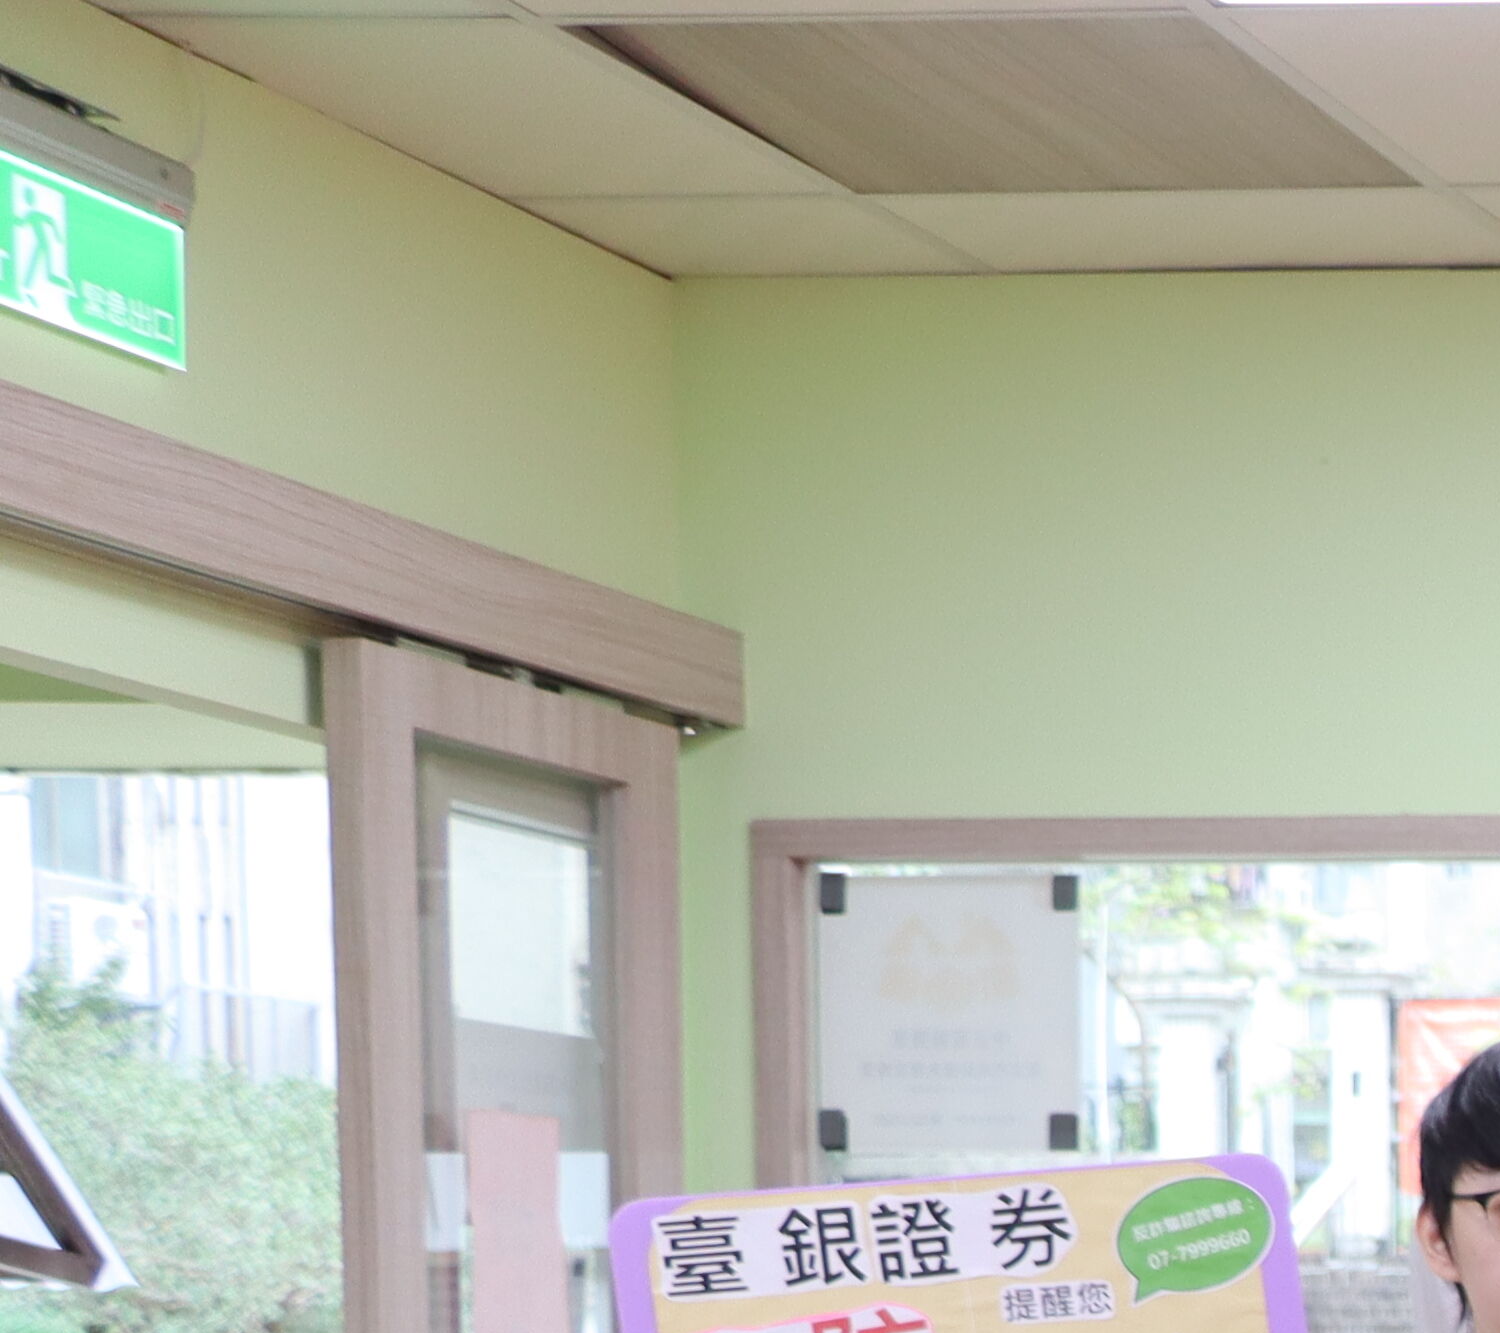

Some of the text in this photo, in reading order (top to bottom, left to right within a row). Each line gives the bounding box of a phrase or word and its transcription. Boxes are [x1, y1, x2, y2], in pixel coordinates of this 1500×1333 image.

[659, 1187, 1071, 1299] 臺銀證券
[1002, 1284, 1112, 1324] 提醒您
